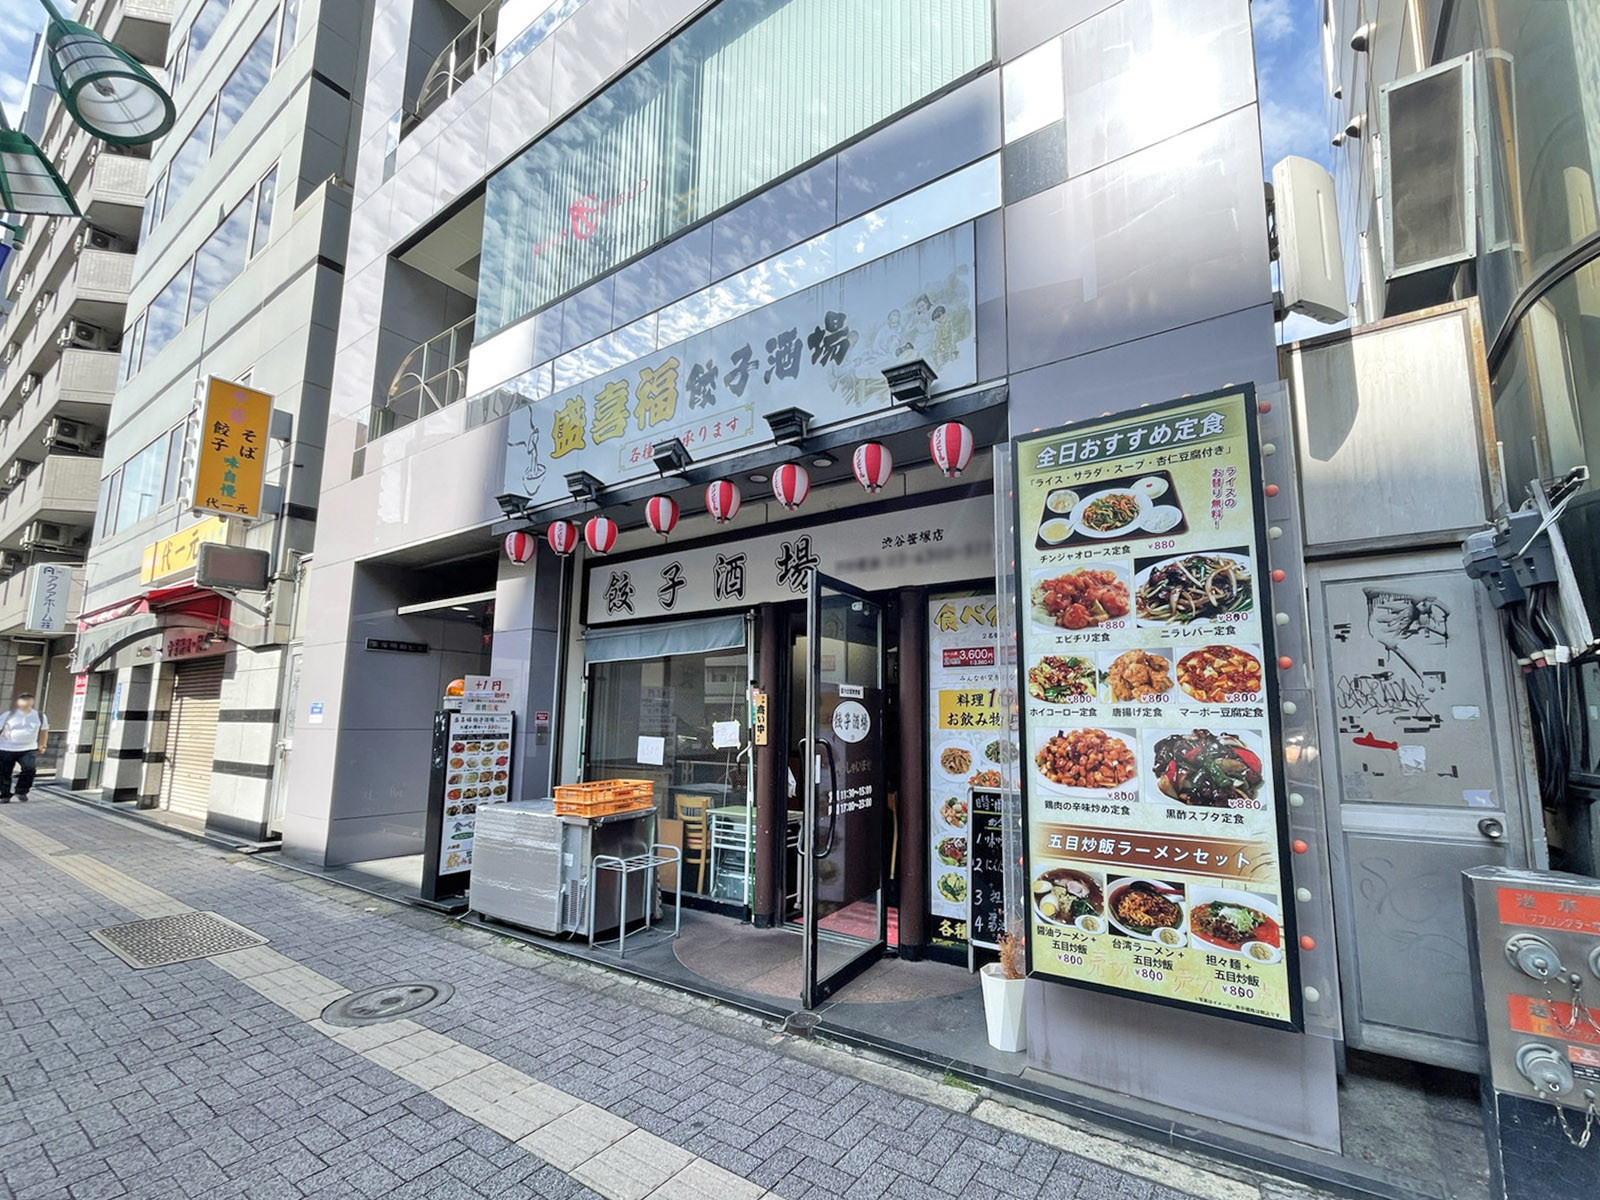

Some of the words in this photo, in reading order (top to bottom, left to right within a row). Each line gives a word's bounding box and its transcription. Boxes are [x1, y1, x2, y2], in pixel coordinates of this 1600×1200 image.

[685, 311, 851, 410] 餃子酒場
[211, 420, 231, 451] 餃子
[239, 429, 258, 460] そば
[630, 417, 739, 462] 各種承ります
[1036, 412, 1226, 468] 全日おすすめ定食
[221, 456, 239, 499] 味自慢
[1225, 466, 1237, 508] ライスの
[205, 497, 249, 514] 代一元
[881, 528, 945, 549] 渋谷笹塚店
[1149, 540, 1176, 551] ¥880
[1040, 545, 1131, 564] チンジャオロース定食
[603, 534, 821, 615] 餃子酒場
[1055, 633, 1111, 644] エビチリ定食
[1160, 626, 1237, 639] ニラレバー定食
[1029, 707, 1098, 718] ホイコーロー定食
[1112, 707, 1163, 718] 唐揚げ定食
[1179, 707, 1264, 718] マーボー豆腐定食
[1044, 800, 1131, 816] 鶏肉の辛味炒め定食
[1166, 809, 1245, 825] 黒酢スブタ定食
[1047, 832, 1250, 869] 五目炒飯ラーメンセット
[1052, 939, 1088, 955] 五目炒飯
[1133, 953, 1174, 971] 五目炒飯
[1214, 969, 1260, 987] 五目炒飯
